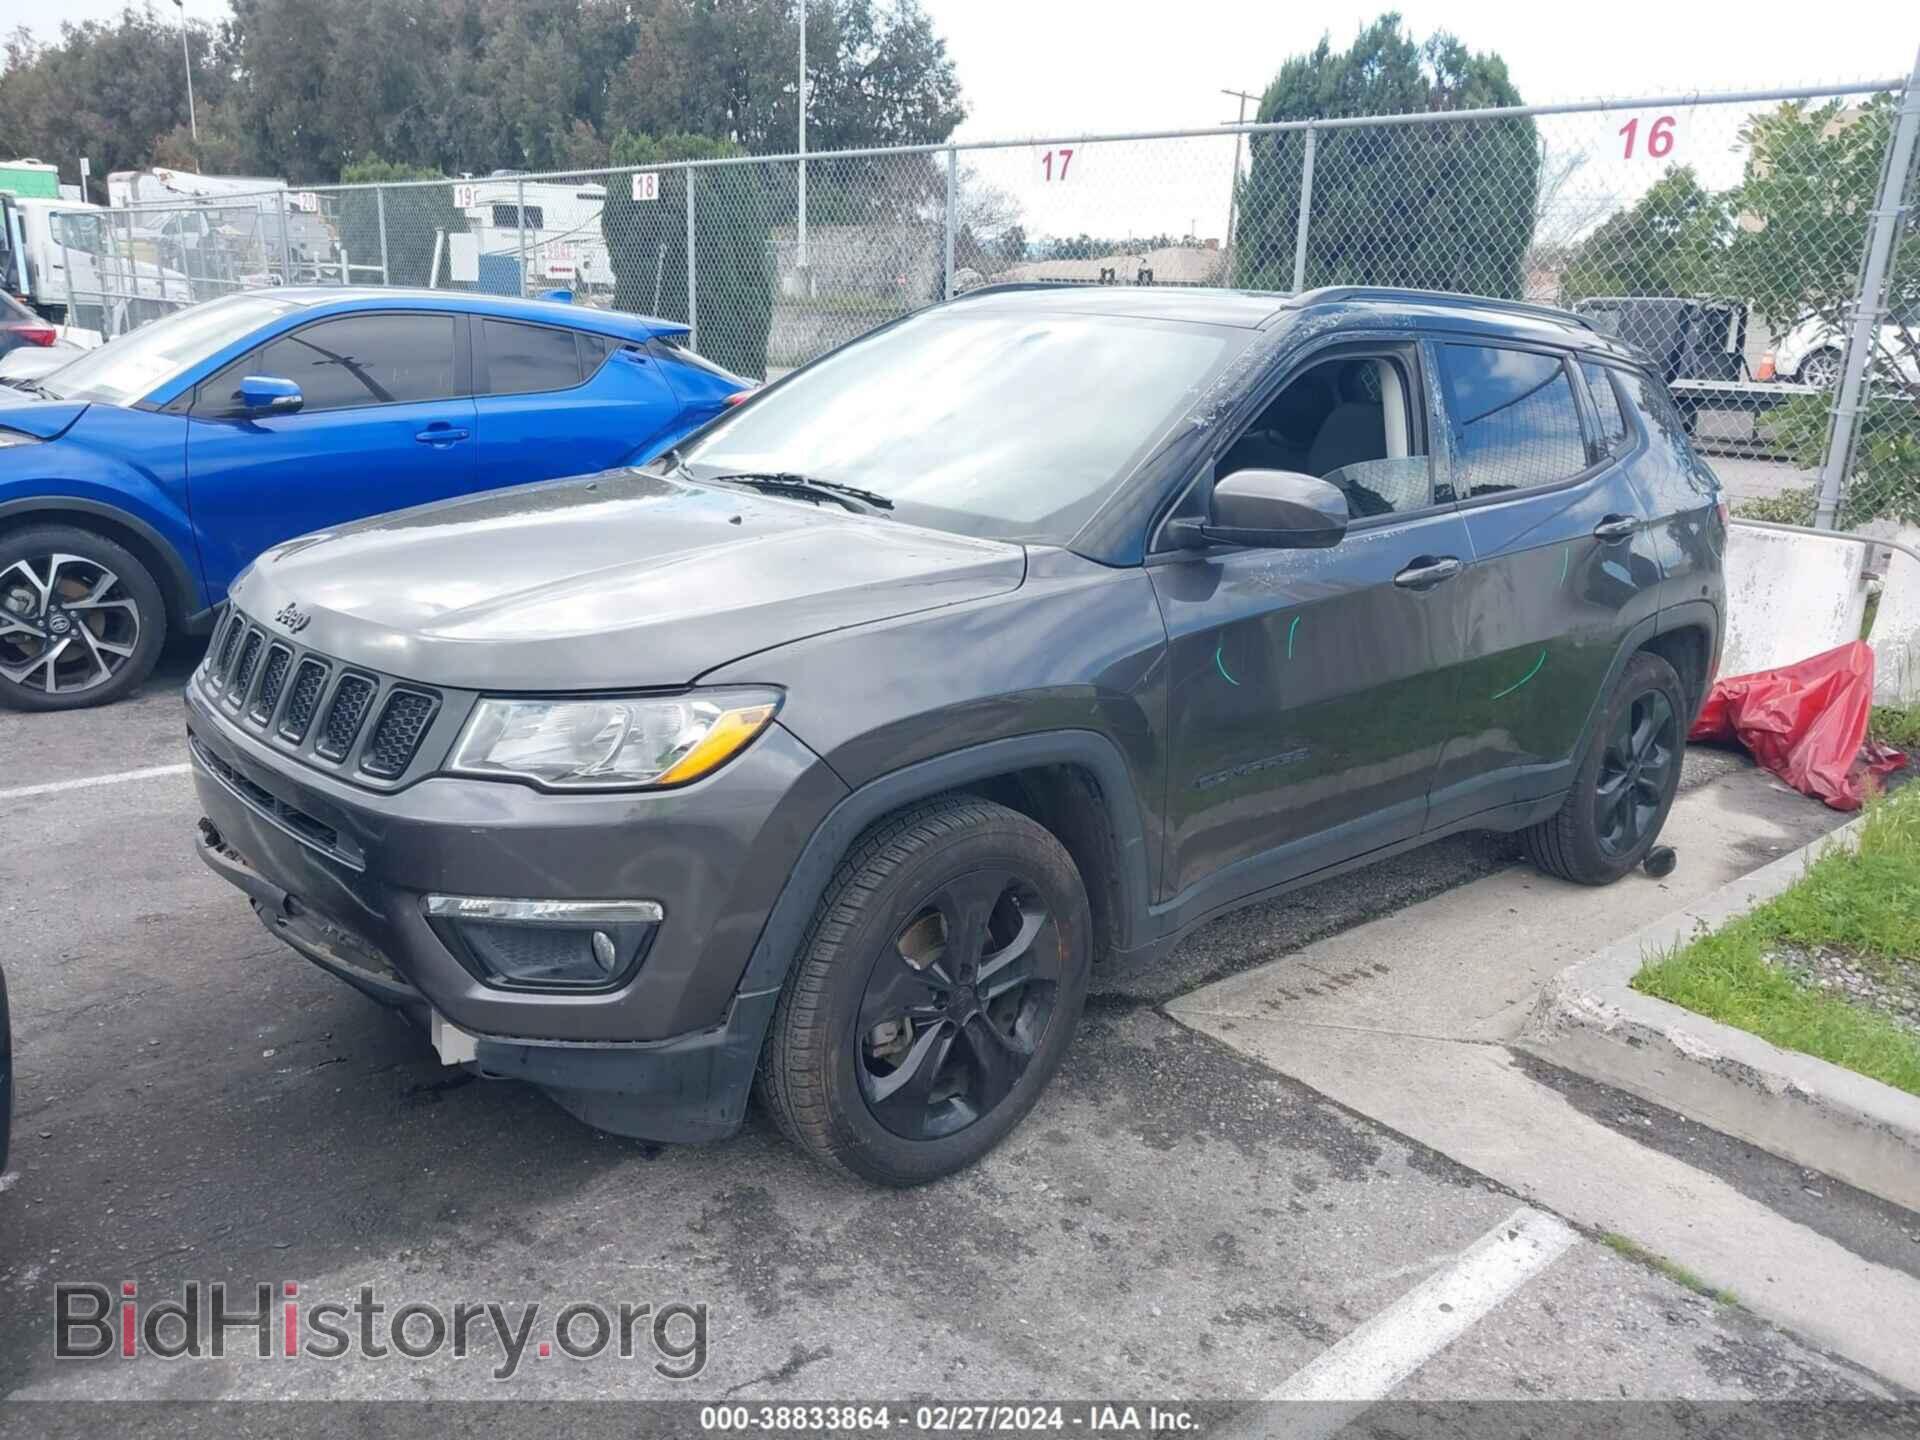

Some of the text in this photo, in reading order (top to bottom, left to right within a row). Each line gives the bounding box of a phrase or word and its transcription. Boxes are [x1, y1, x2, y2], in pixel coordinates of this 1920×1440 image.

[1619, 116, 1676, 160] 16
[1042, 149, 1074, 181] 17
[458, 186, 471, 202] 19
[637, 174, 653, 198] 18
[275, 602, 311, 635] Jeep
